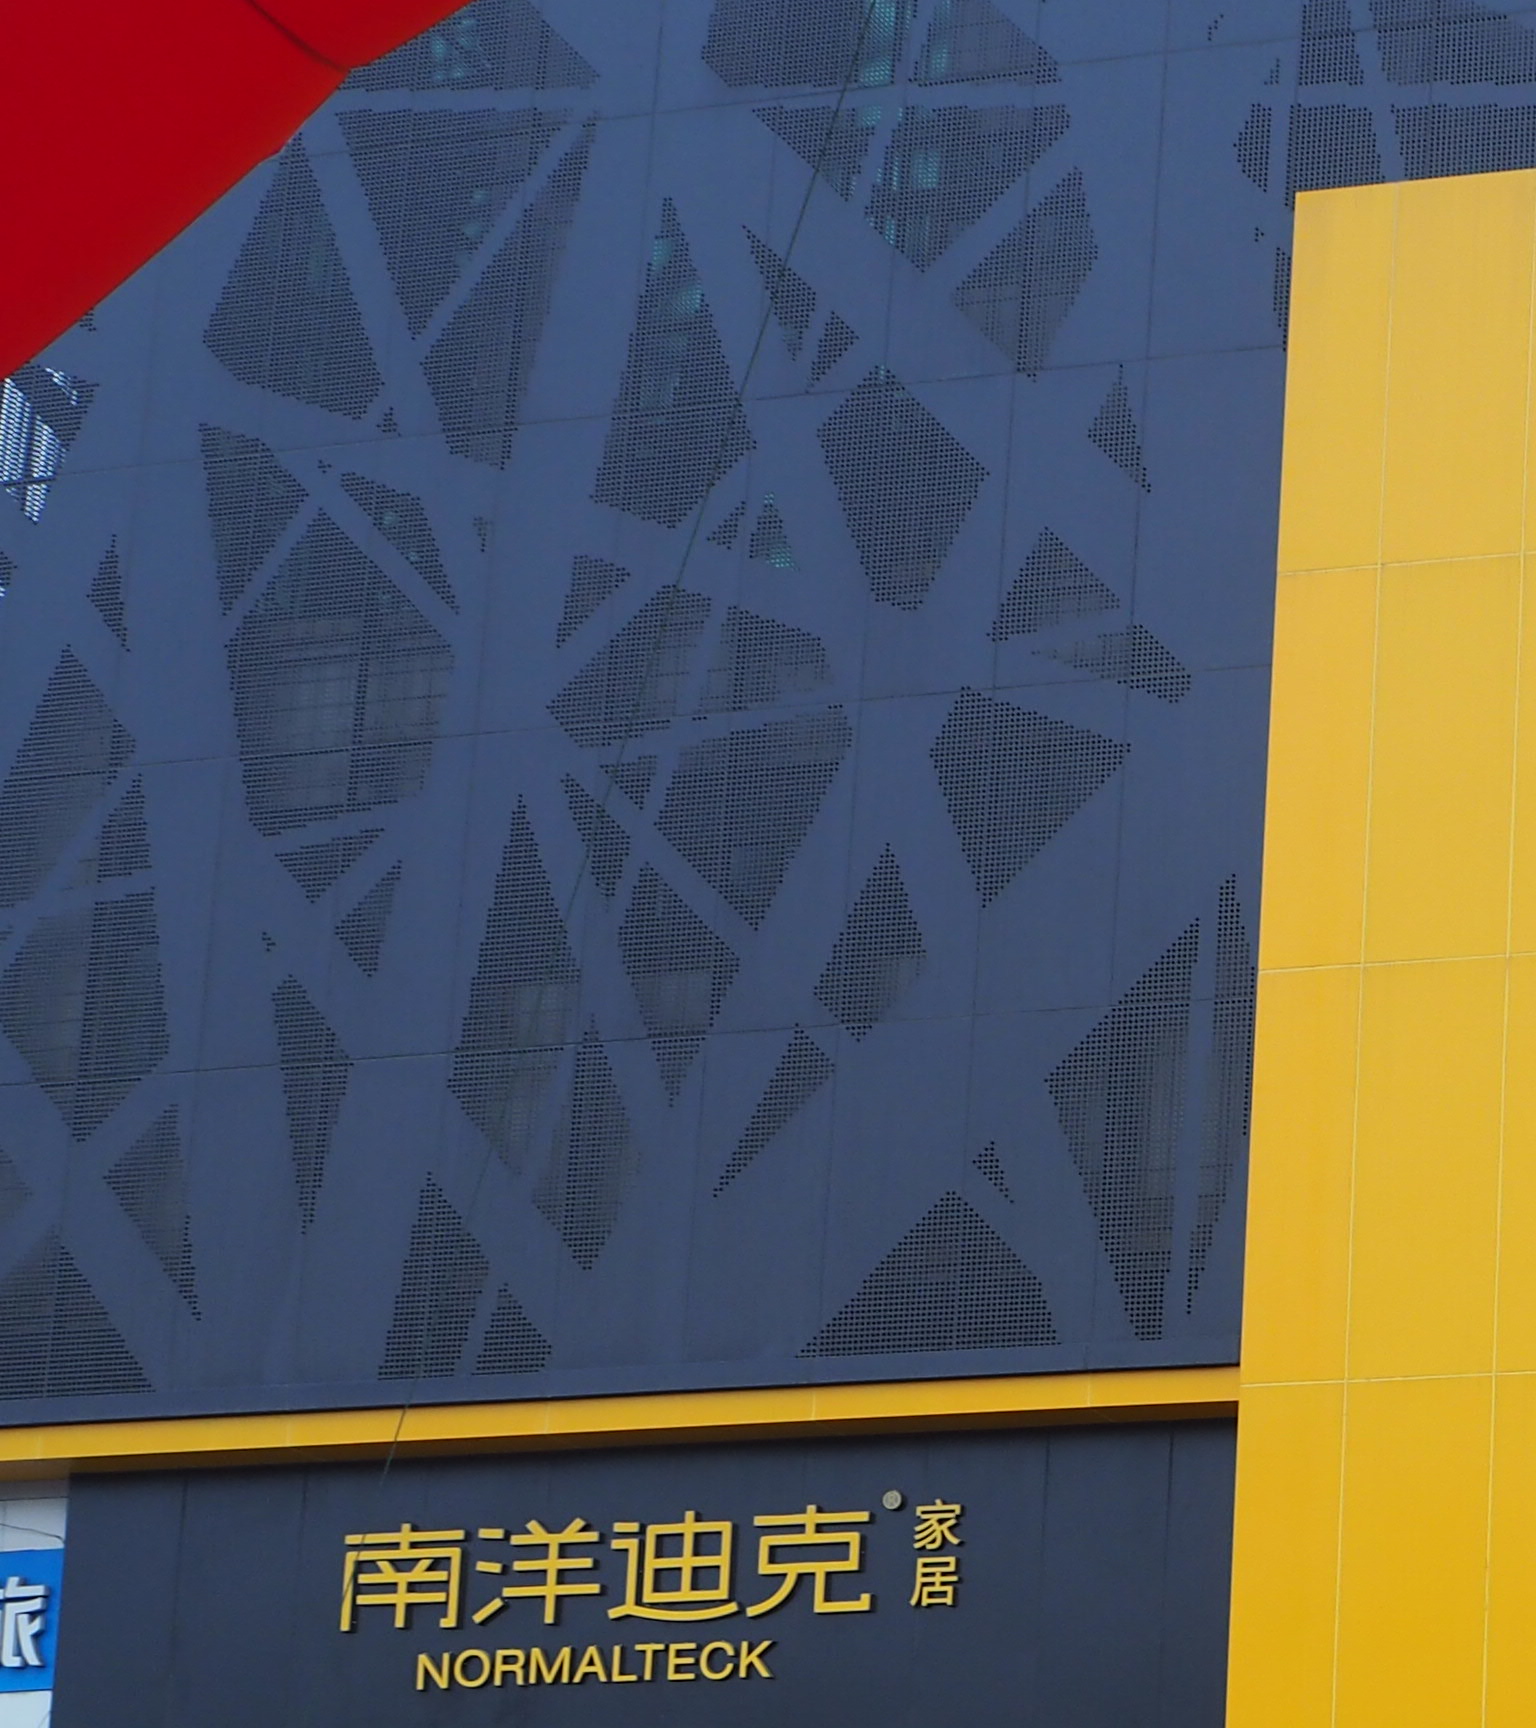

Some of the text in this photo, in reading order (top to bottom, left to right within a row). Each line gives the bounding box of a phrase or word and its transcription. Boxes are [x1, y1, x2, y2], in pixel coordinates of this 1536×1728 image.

[338, 1503, 872, 1633] 南洋迪克
[909, 1498, 962, 1607] 家居
[415, 1640, 775, 1691] NORMALTECK
